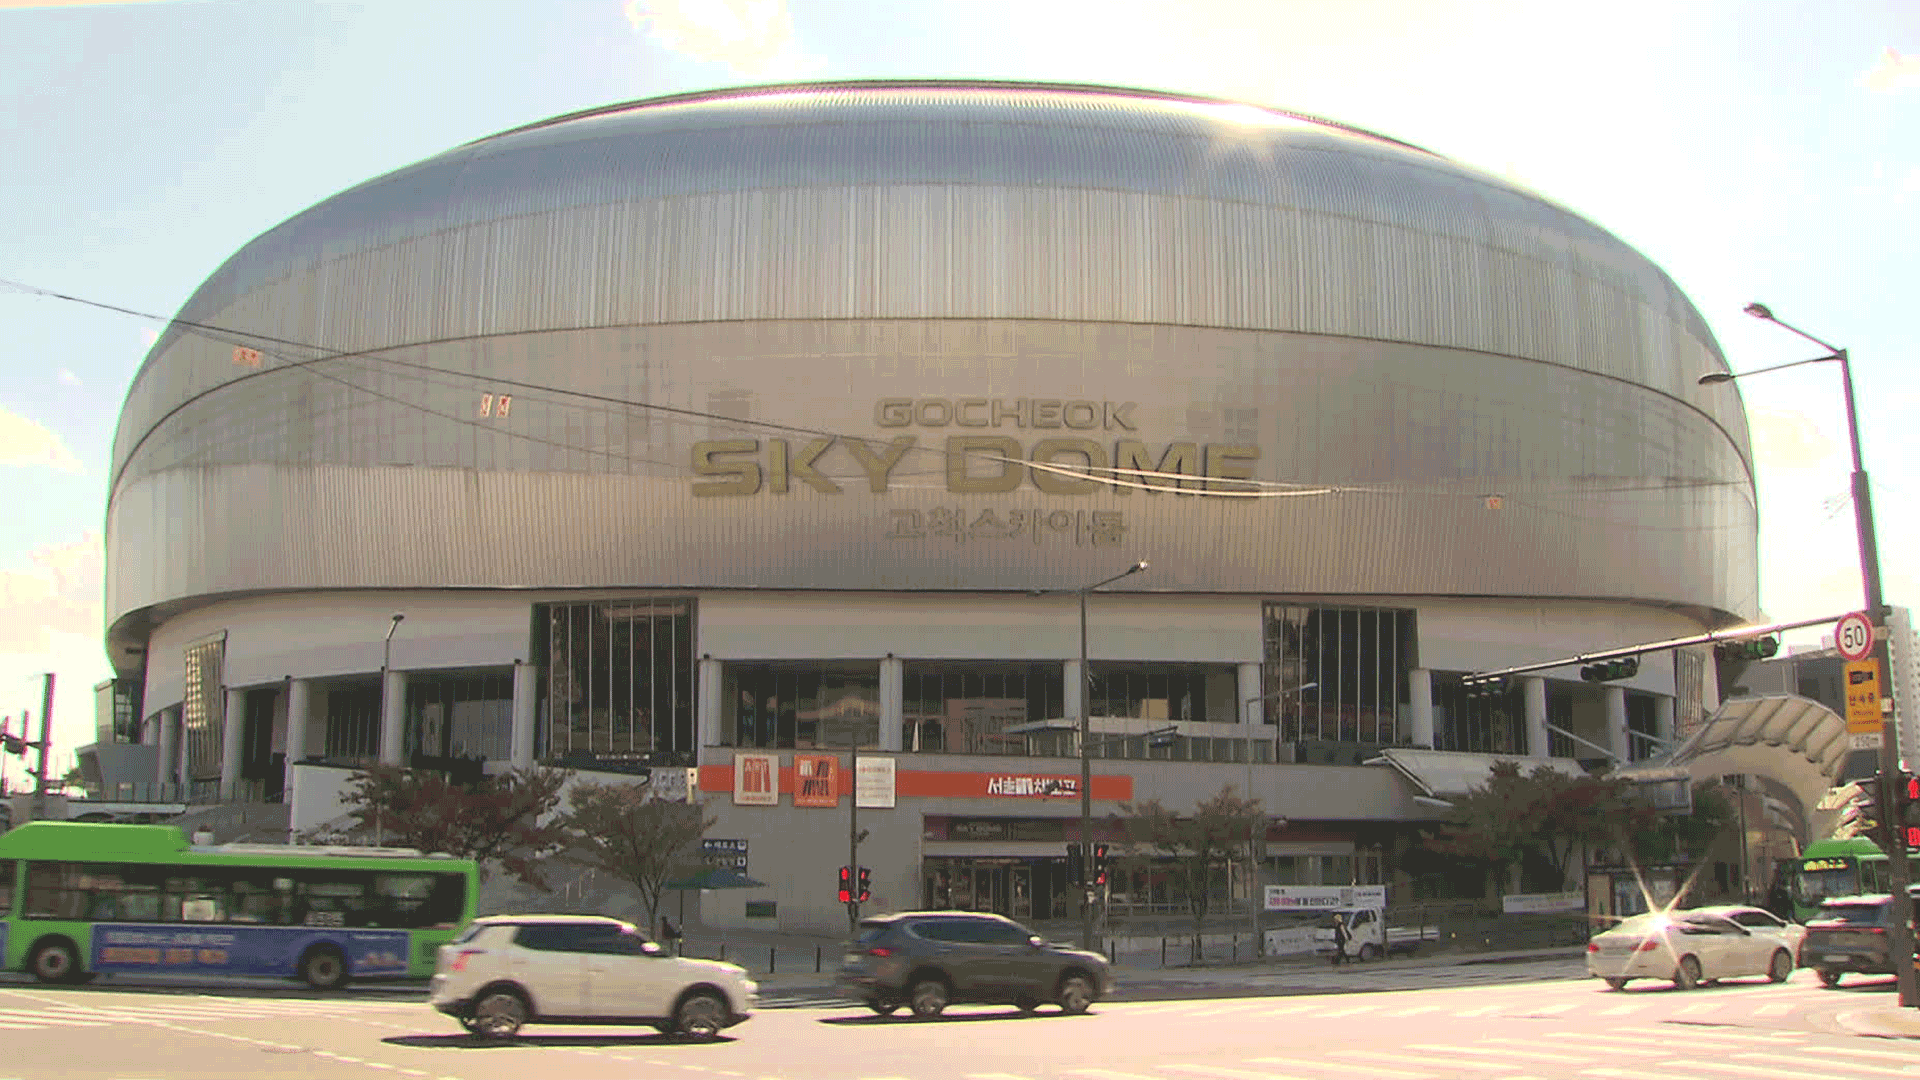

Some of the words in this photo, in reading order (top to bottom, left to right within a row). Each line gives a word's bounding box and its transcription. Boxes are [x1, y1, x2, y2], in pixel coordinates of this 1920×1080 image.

[873, 397, 1138, 432] GOCHEOK
[690, 436, 918, 497] SKY
[946, 435, 1262, 498] DOME
[885, 507, 1127, 547] 고척스카이돔
[1843, 625, 1864, 648] 50
